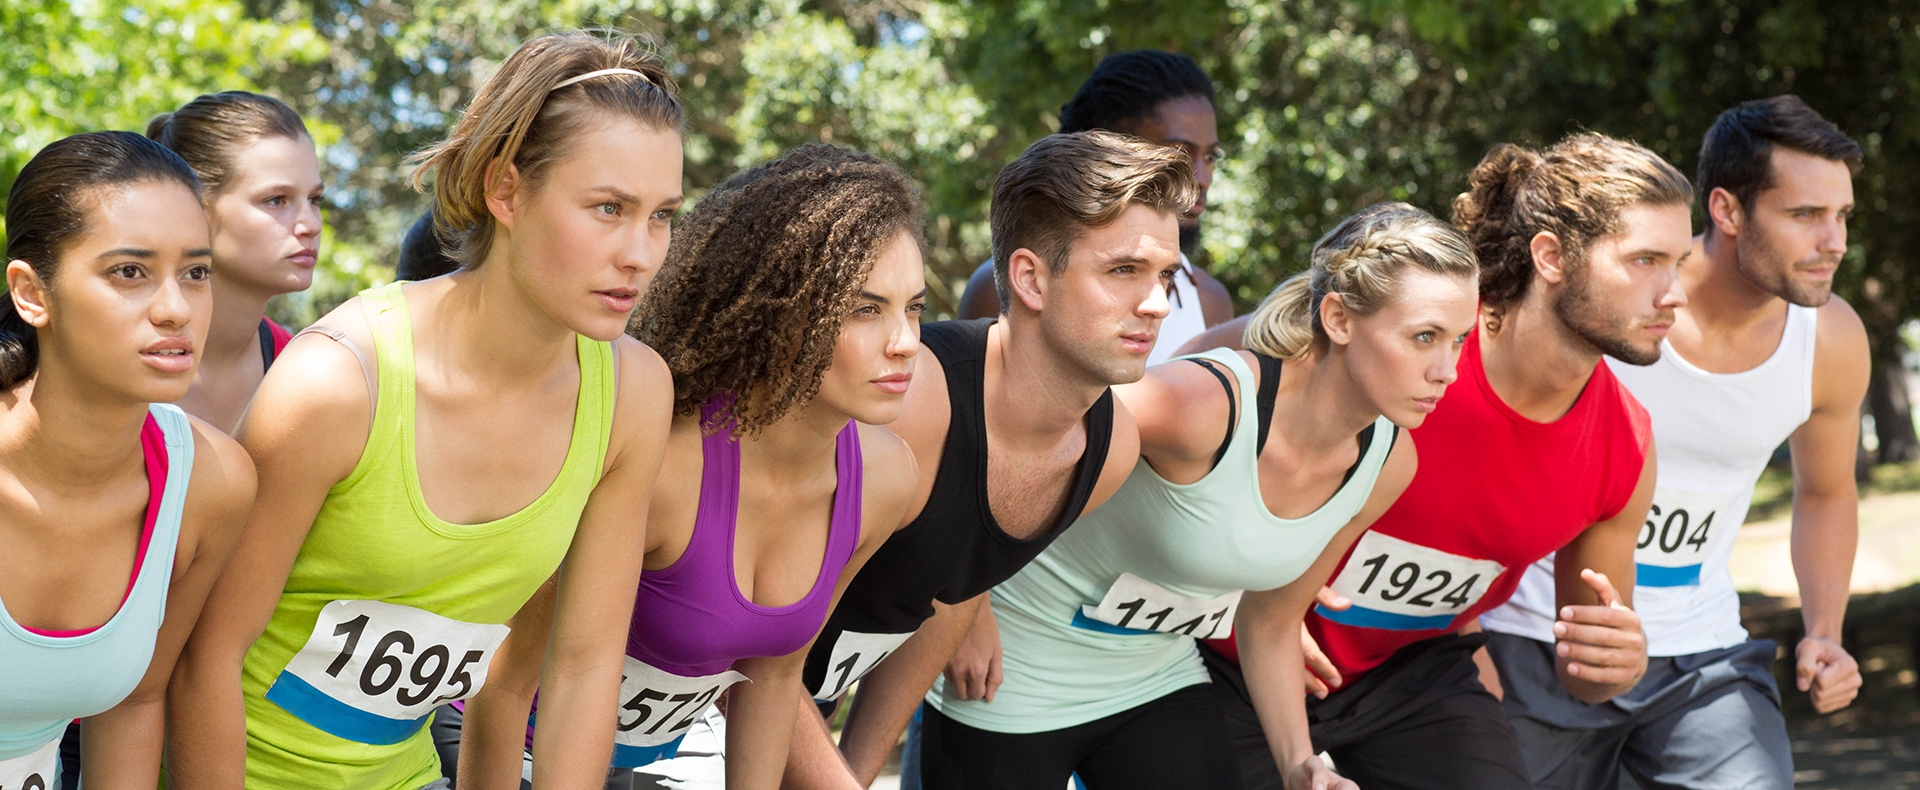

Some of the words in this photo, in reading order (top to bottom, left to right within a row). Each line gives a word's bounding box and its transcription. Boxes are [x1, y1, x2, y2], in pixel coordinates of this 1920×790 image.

[1357, 553, 1481, 609] 1924
[325, 613, 485, 707] 1695
[617, 674, 721, 735] 572
